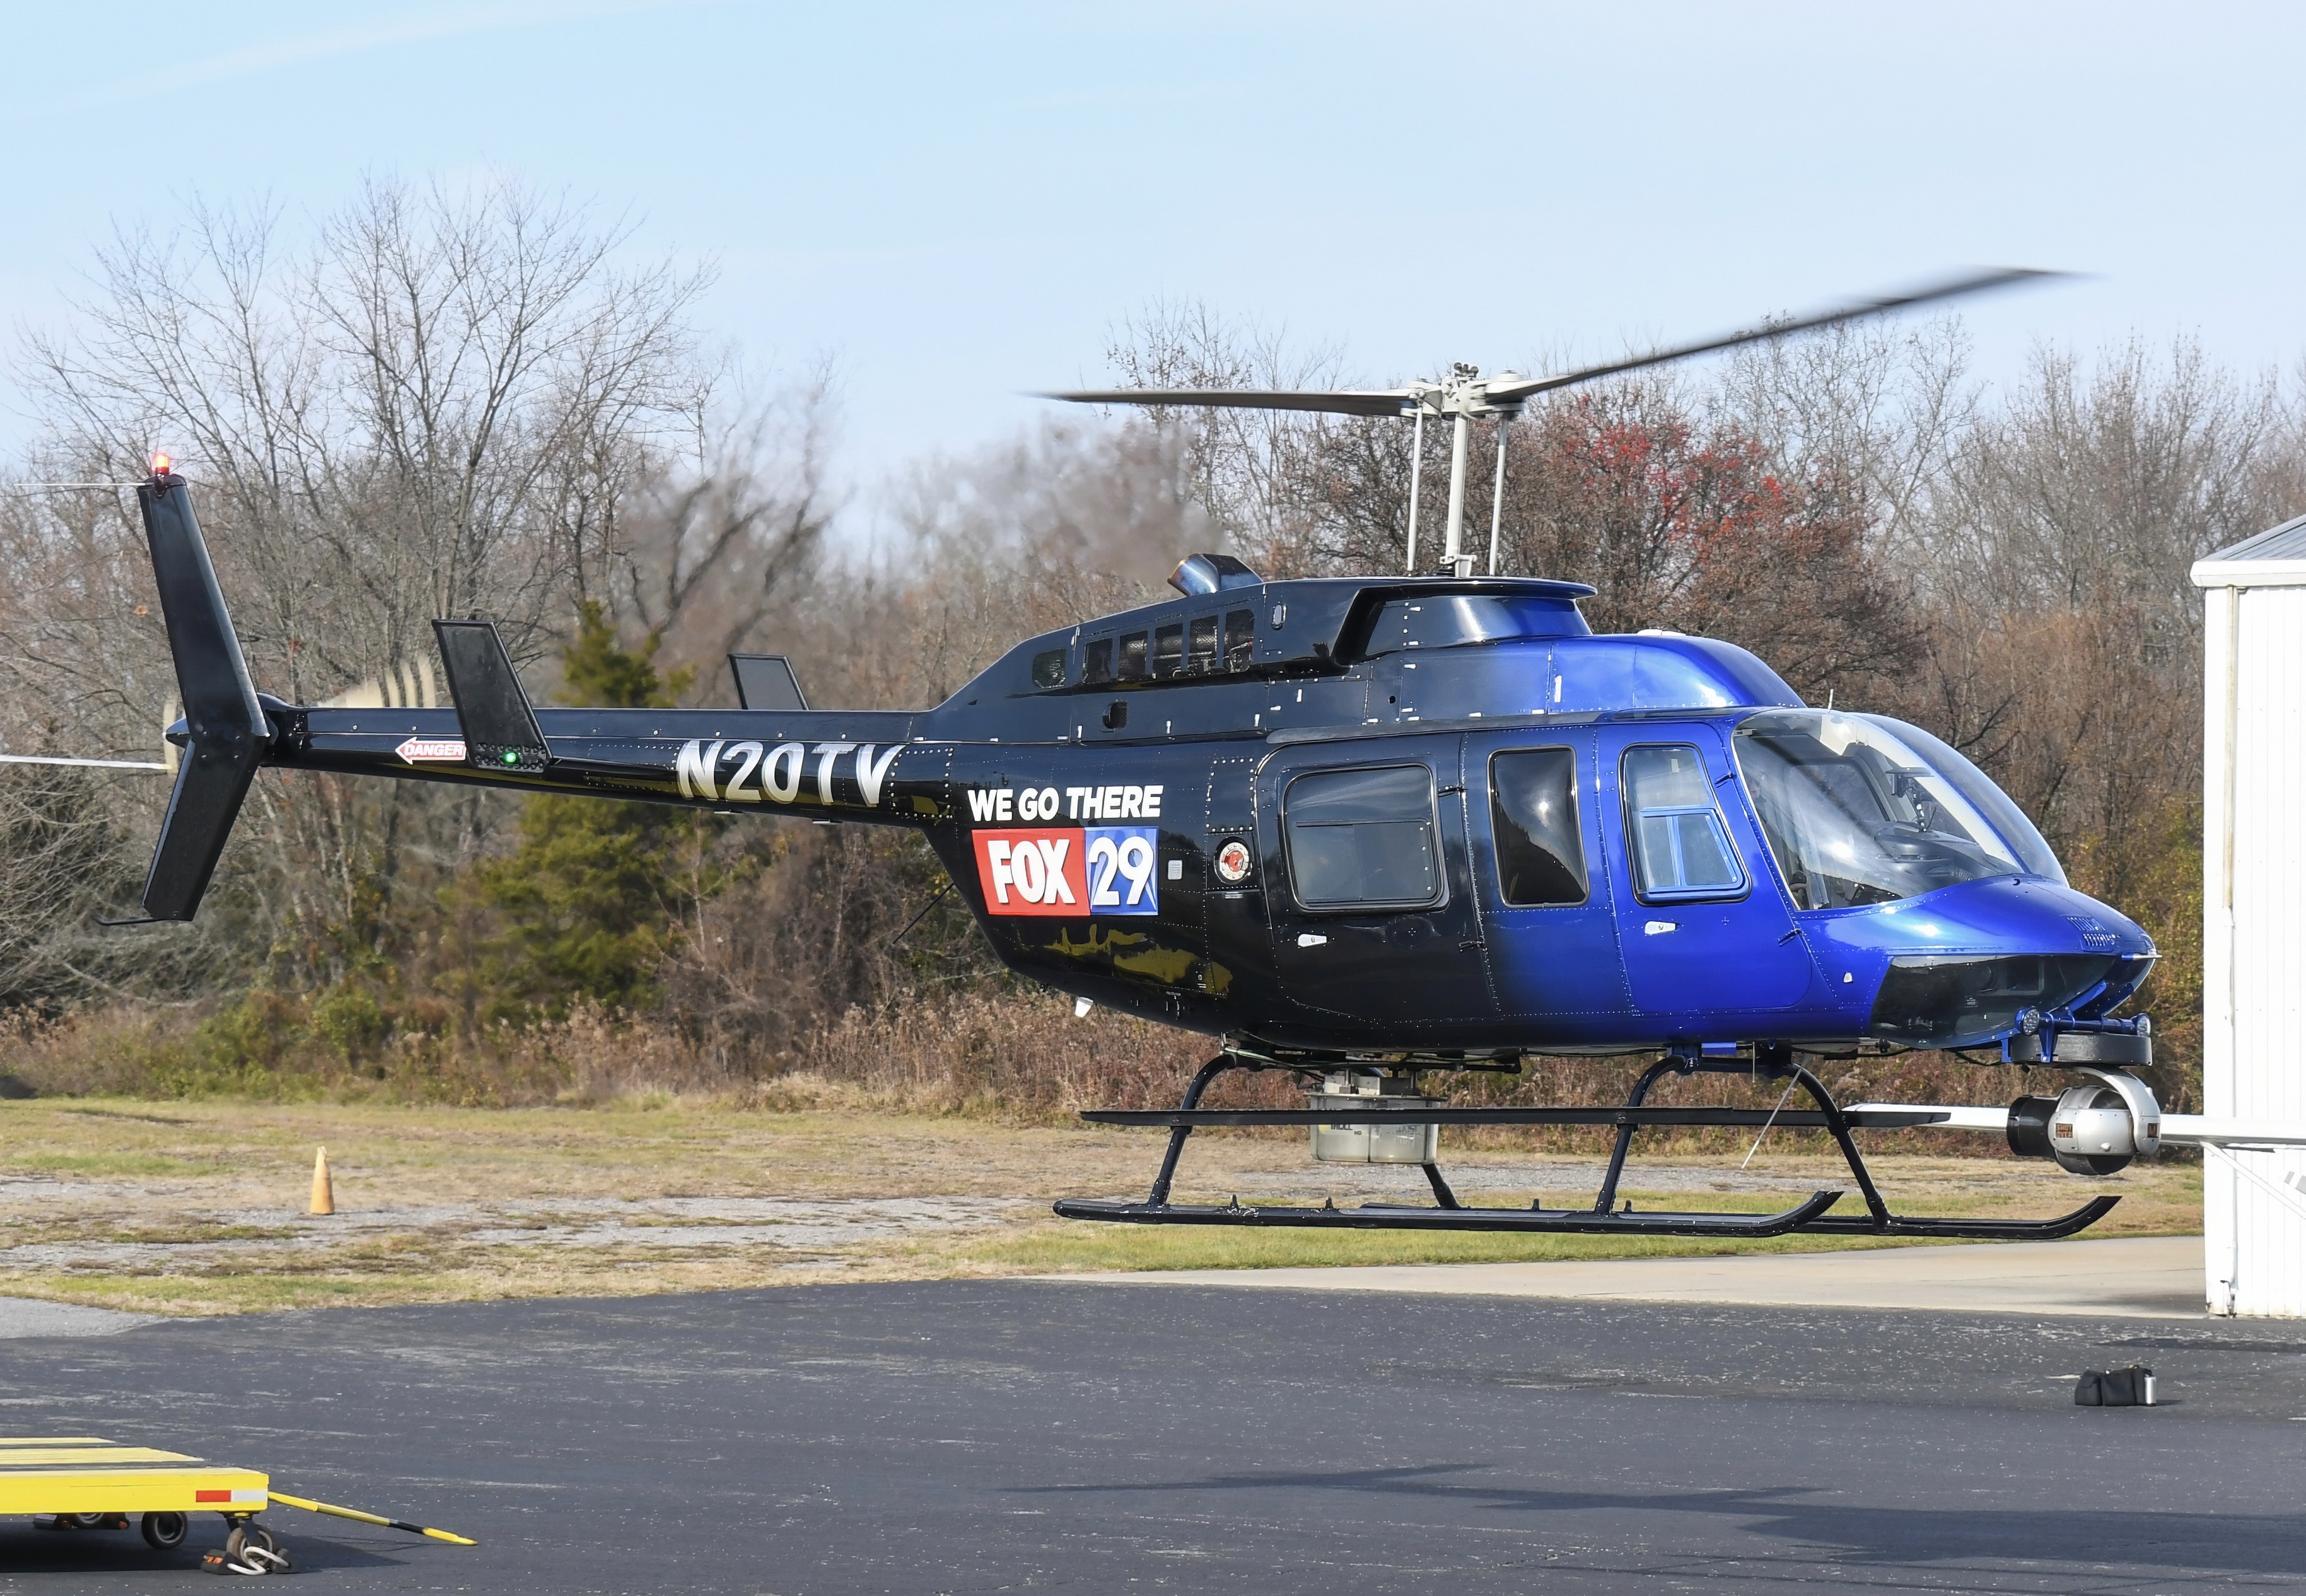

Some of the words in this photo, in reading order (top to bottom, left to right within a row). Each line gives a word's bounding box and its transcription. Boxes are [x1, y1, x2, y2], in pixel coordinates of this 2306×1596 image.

[404, 744, 463, 756] DANGER
[676, 740, 906, 807] N20TV
[967, 789, 1013, 822] WE
[1018, 787, 1059, 820] GO
[1066, 785, 1164, 819] THERE
[987, 839, 1076, 904] FOX
[1088, 836, 1155, 906] 29
